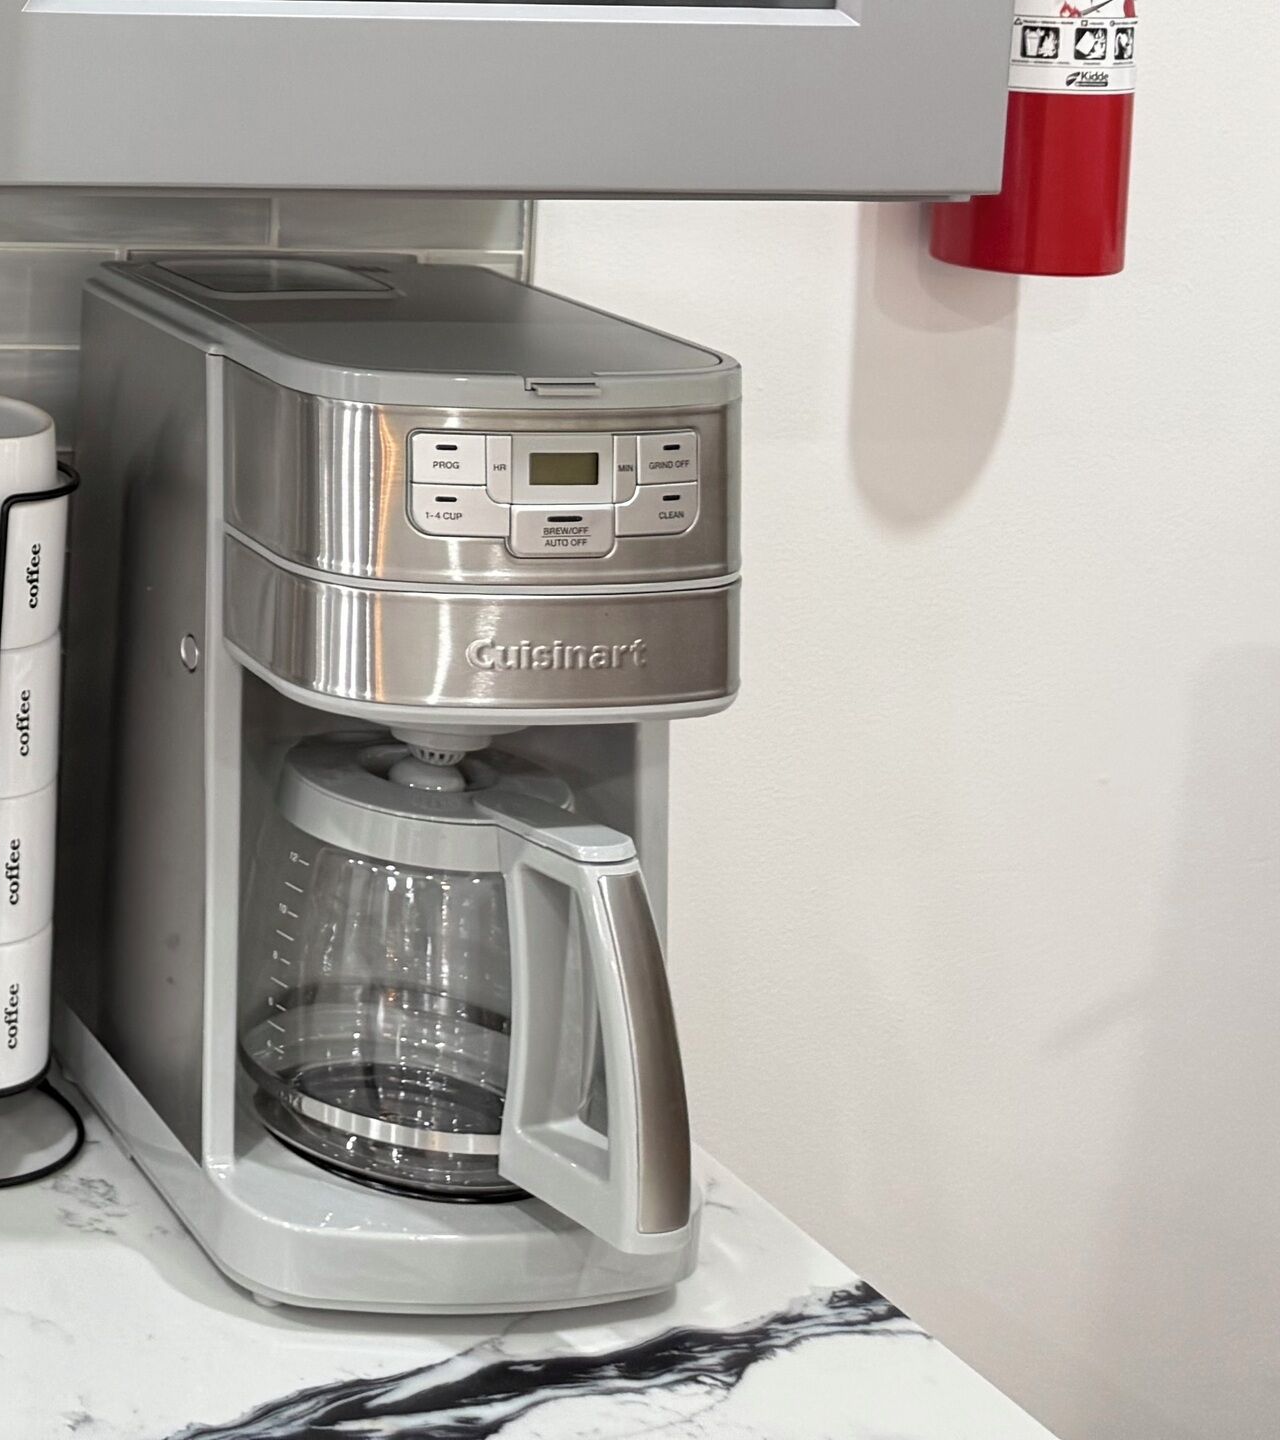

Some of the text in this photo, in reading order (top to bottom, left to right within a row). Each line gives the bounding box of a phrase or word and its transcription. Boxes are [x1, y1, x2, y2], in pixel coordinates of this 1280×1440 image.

[1081, 71, 1109, 82] Kidde
[432, 460, 460, 471] PROG
[493, 463, 507, 472] HR
[618, 464, 634, 473] MIN
[648, 460, 690, 470] GRIND OFF
[443, 512, 463, 521] CUP
[658, 511, 685, 520] CLEAN
[543, 526, 590, 536] BREW/OFF
[544, 538, 588, 548] AUTO OFF
[28, 543, 42, 609] coffee
[465, 639, 647, 671] Cuisinart
[18, 689, 32, 757] coffee
[5, 838, 21, 906] coffee
[4, 983, 20, 1050] coffee
